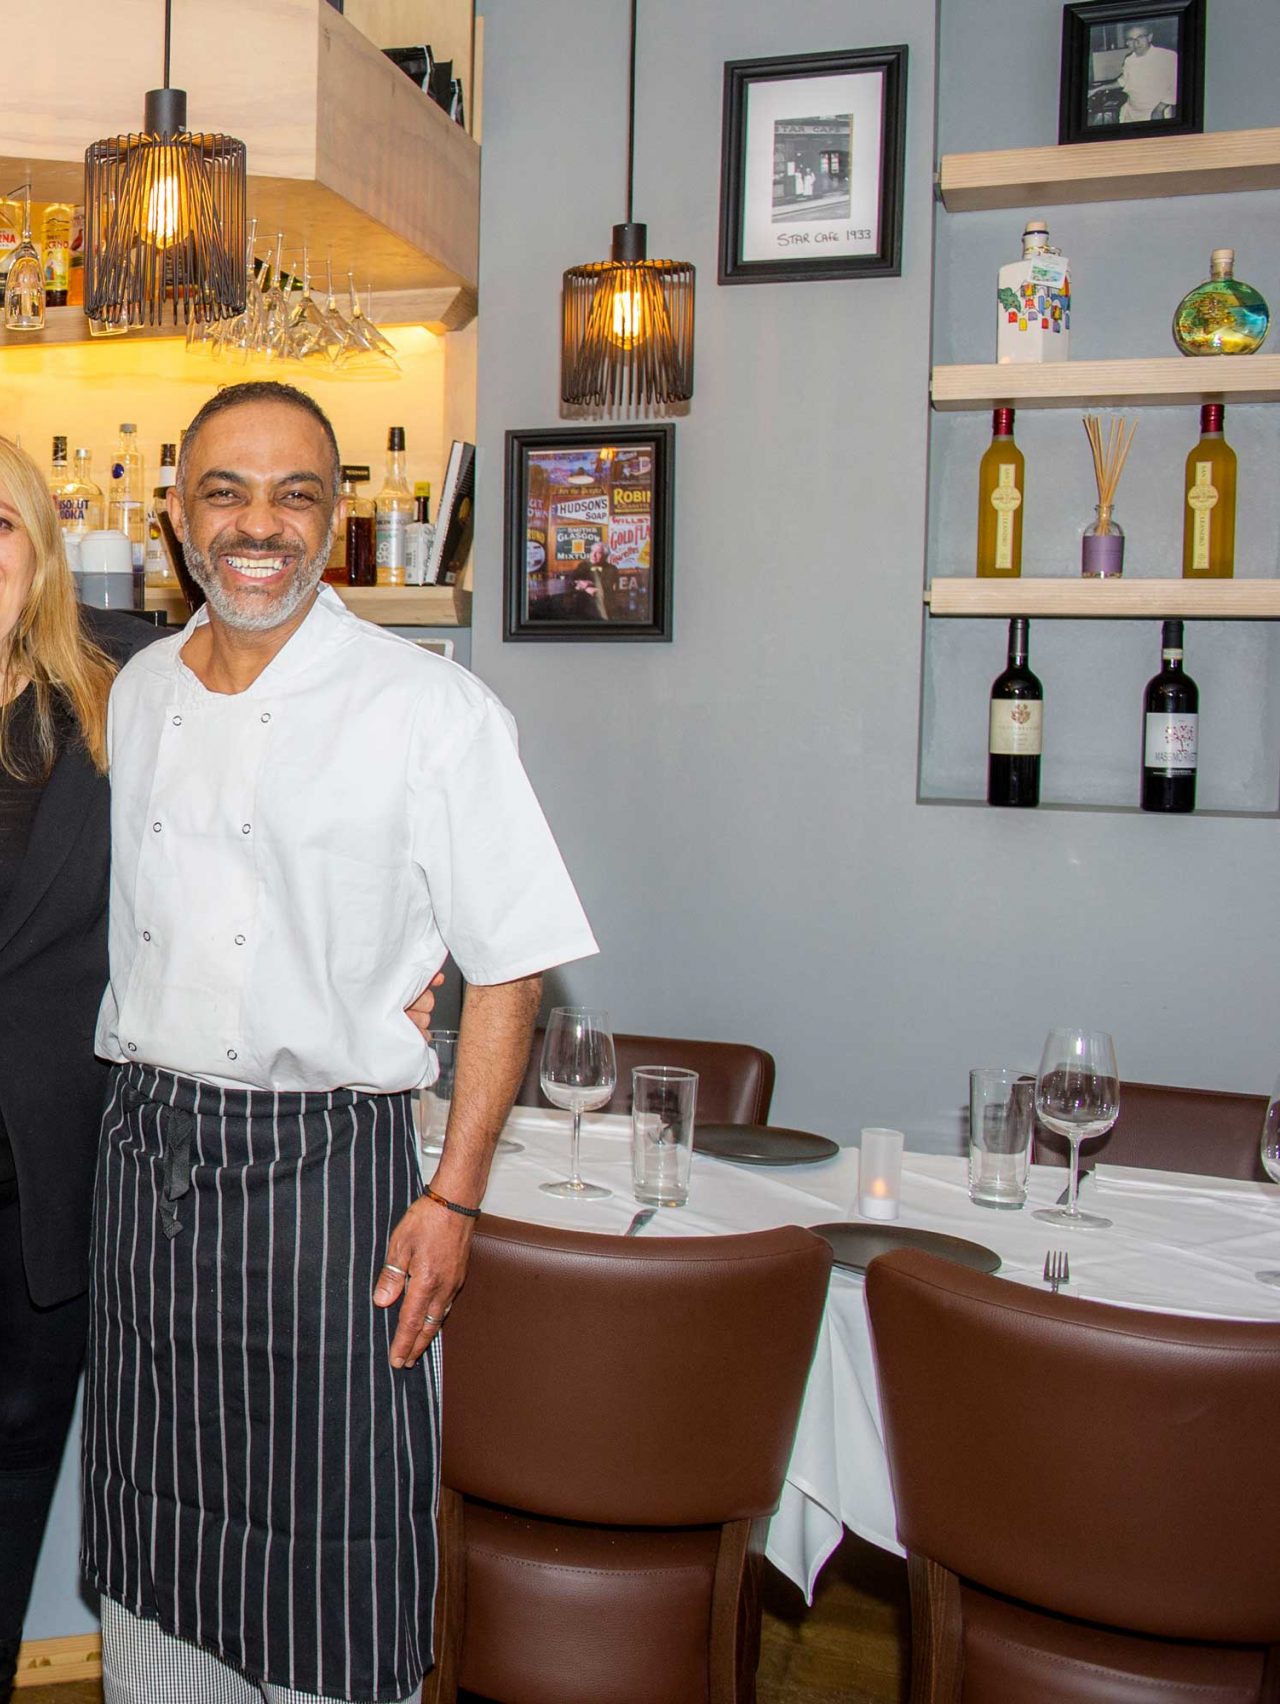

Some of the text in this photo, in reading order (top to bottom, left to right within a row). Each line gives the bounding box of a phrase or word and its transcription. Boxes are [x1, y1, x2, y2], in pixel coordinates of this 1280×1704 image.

[776, 232, 810, 247] STAR
[846, 229, 872, 240] 1933
[559, 498, 608, 515] HUDSON'S
[585, 512, 607, 520] SOAP
